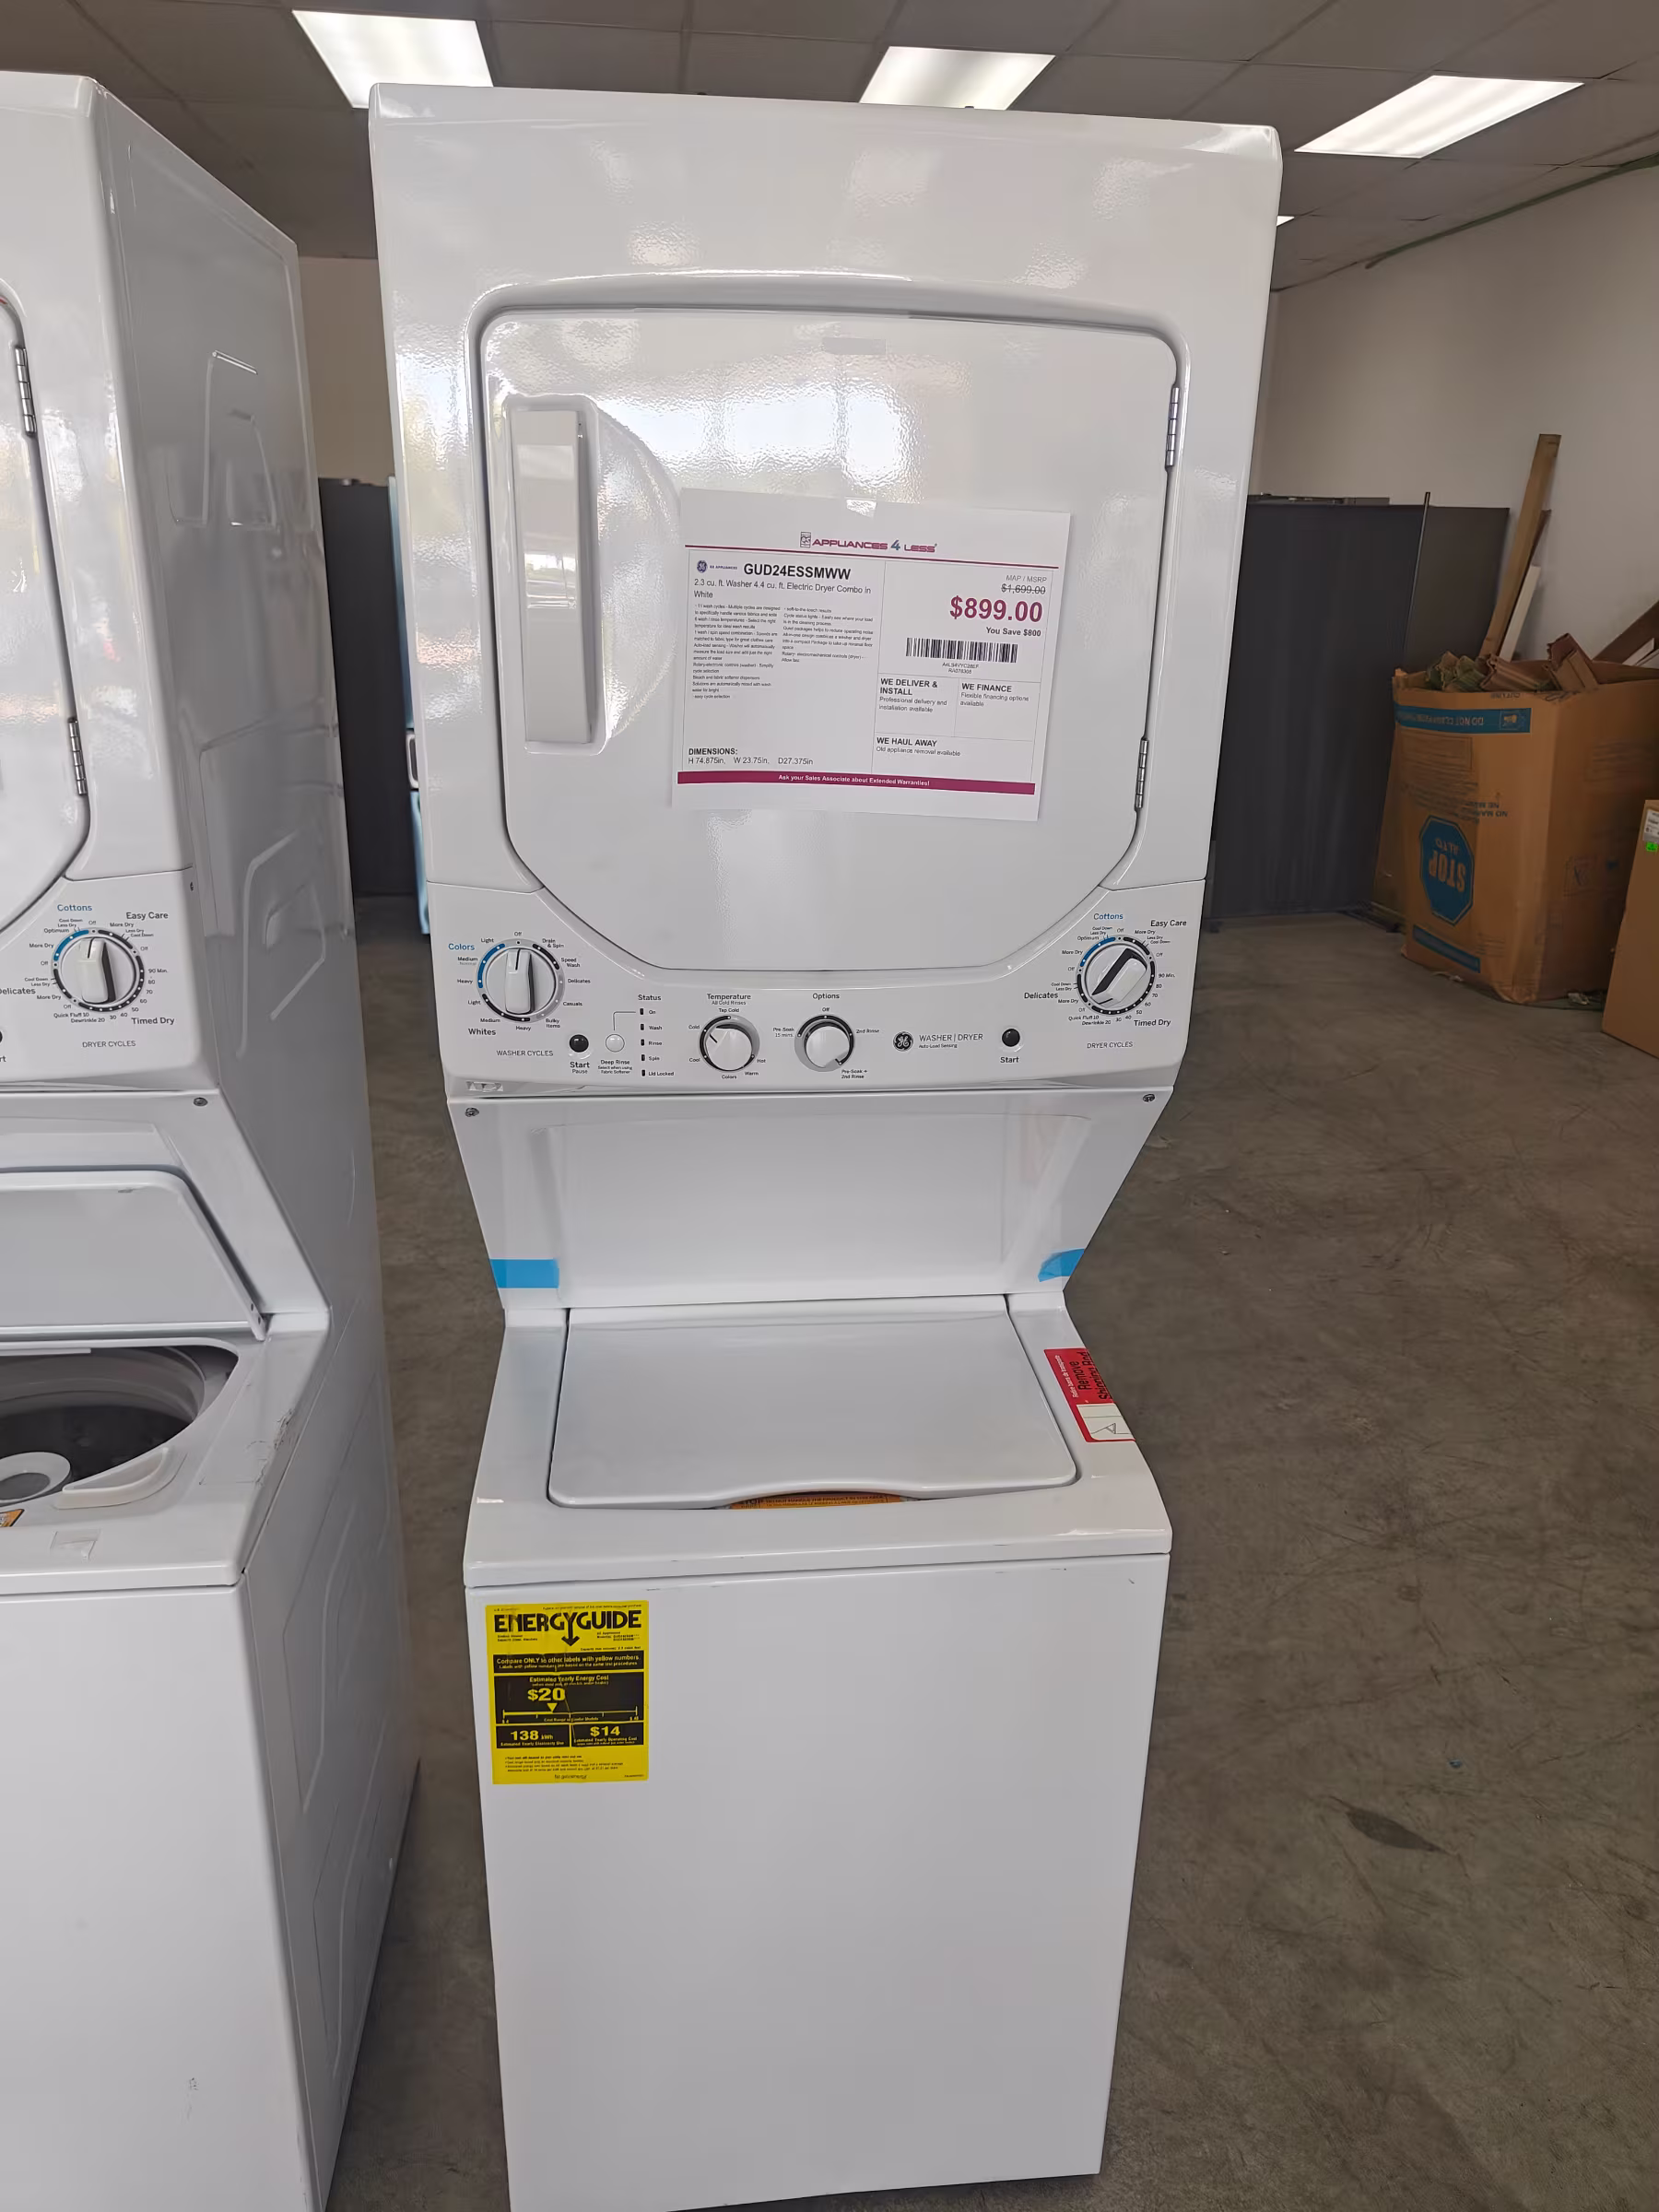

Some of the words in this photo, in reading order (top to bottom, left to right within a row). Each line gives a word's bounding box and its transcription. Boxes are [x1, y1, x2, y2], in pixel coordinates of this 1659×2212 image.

[812, 539, 888, 549] APPLIANCES
[891, 540, 900, 550] 4
[904, 545, 935, 553] LESS
[744, 563, 851, 580] GUD24ESSMWW
[816, 584, 834, 593] Dryer
[1001, 584, 1046, 594] $1,699.00
[950, 595, 1042, 622] $899.00
[1023, 629, 1041, 637] $800
[977, 684, 1012, 692] FINANCE
[1428, 850, 1466, 892] STOP
[1069, 1361, 1092, 1390] Remove
[494, 1610, 641, 1632] ENERGYGUIDE
[527, 1688, 565, 1701] $20
[511, 1730, 538, 1741] 138
[590, 1726, 620, 1736] $14
